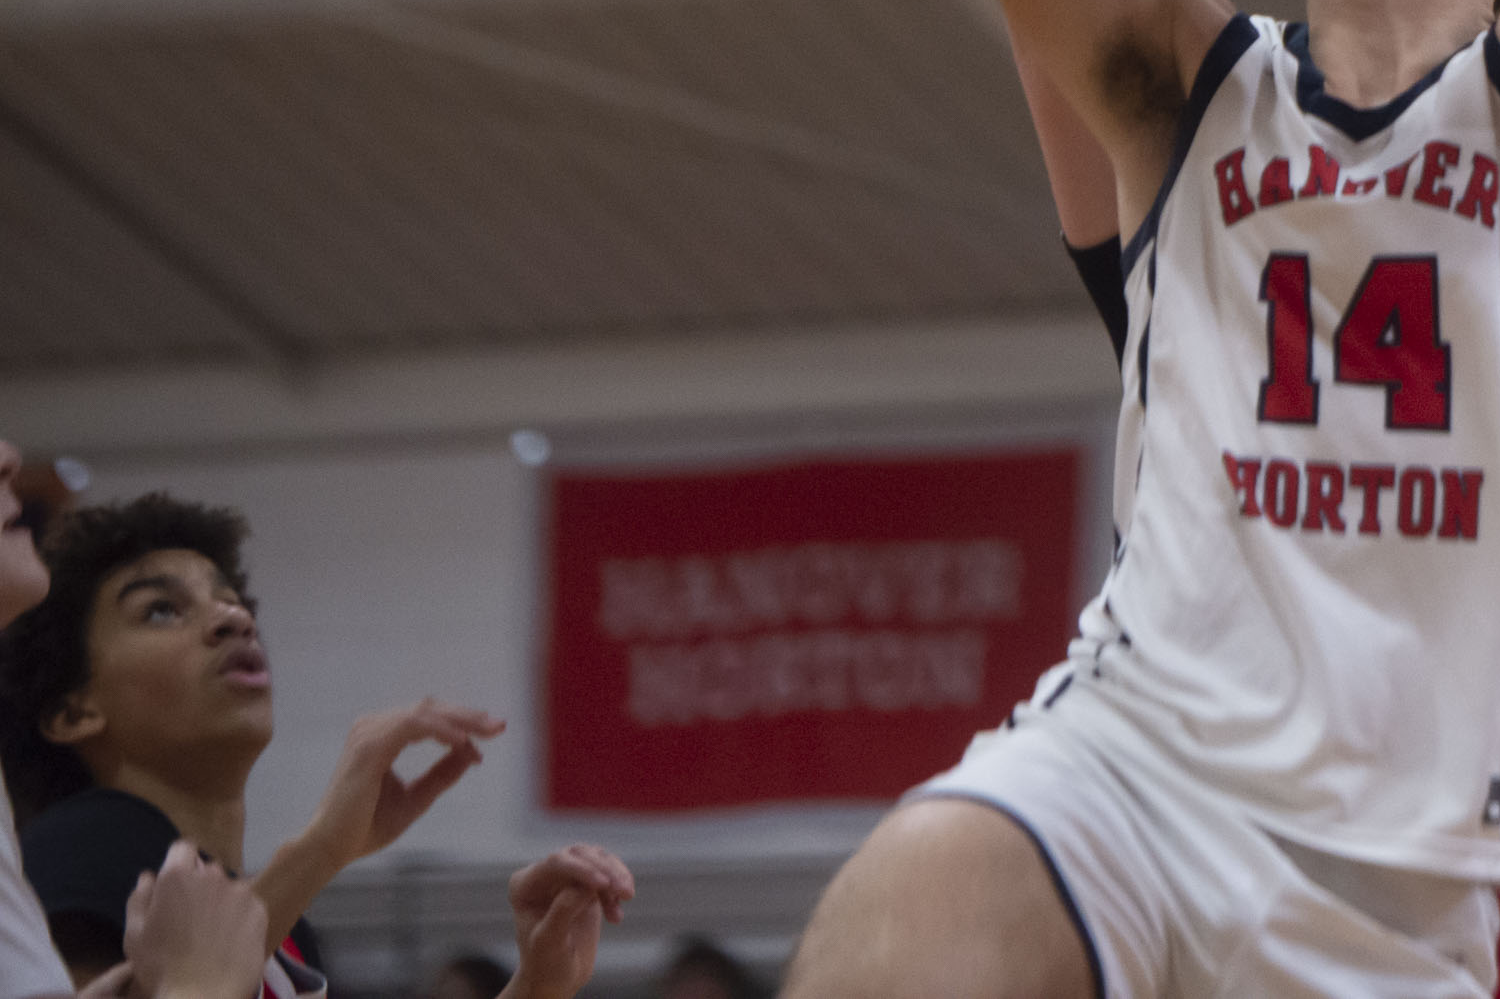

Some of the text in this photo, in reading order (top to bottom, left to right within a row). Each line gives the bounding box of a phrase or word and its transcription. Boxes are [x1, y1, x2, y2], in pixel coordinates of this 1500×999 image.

[1213, 140, 1500, 230] HANVER
[1257, 251, 1452, 432] 14
[1222, 450, 1484, 540] HORTON
